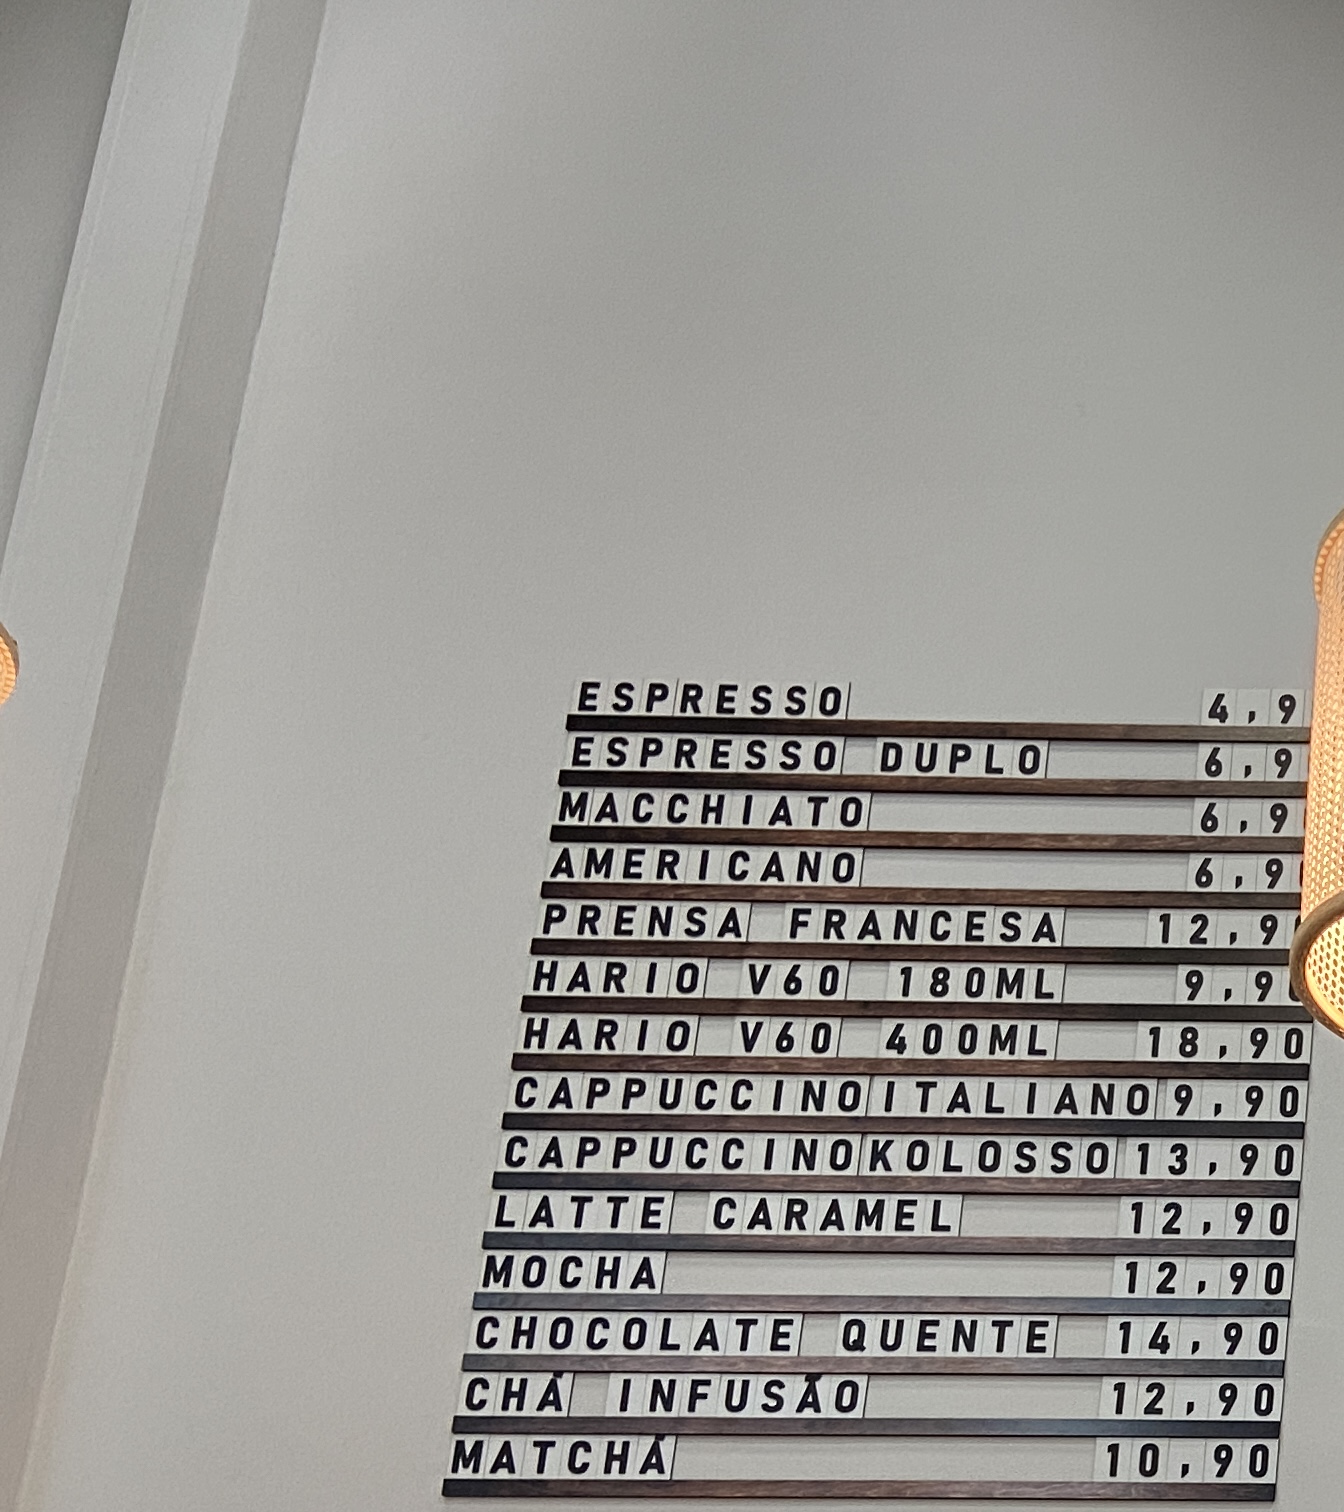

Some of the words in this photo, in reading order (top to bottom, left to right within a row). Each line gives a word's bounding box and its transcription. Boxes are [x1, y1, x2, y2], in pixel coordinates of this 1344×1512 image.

[577, 681, 843, 718] ESPRESSO
[1208, 693, 1297, 725] 4,9
[571, 737, 837, 773] ESPRESSO
[880, 742, 1041, 776] DUPLO
[1204, 747, 1292, 781] 6,9
[559, 792, 863, 829] MACCHIATO
[1200, 803, 1289, 834] 6,9
[550, 848, 856, 884] AMERICANO
[1194, 858, 1283, 892] 6,9
[541, 903, 742, 940] PRENSA
[790, 909, 1057, 944] FRANCESA
[1158, 912, 1298, 946] 12,9
[531, 960, 699, 995] HARIO
[748, 963, 840, 996] V60
[899, 965, 1054, 1000] 180ML
[522, 1017, 690, 1052] HARIO
[739, 1020, 832, 1055] V60
[886, 1021, 1047, 1057] 400ML
[1148, 1025, 1304, 1061] 18,90
[1174, 1085, 1299, 1118] 9,90
[1135, 1142, 1295, 1177] 13,90
[495, 1196, 665, 1231] LATTE
[713, 1197, 951, 1232] CARAMEL
[1130, 1201, 1290, 1236] 12,90
[482, 1255, 657, 1291] MOCHA
[1125, 1260, 1284, 1295] 12,90
[475, 1315, 793, 1352] CHOCOLATE
[842, 1317, 1049, 1354] QUENTE
[1117, 1321, 1279, 1356] 14,90
[1112, 1380, 1275, 1416] 12,90
[1106, 1441, 1270, 1478] 10,90
